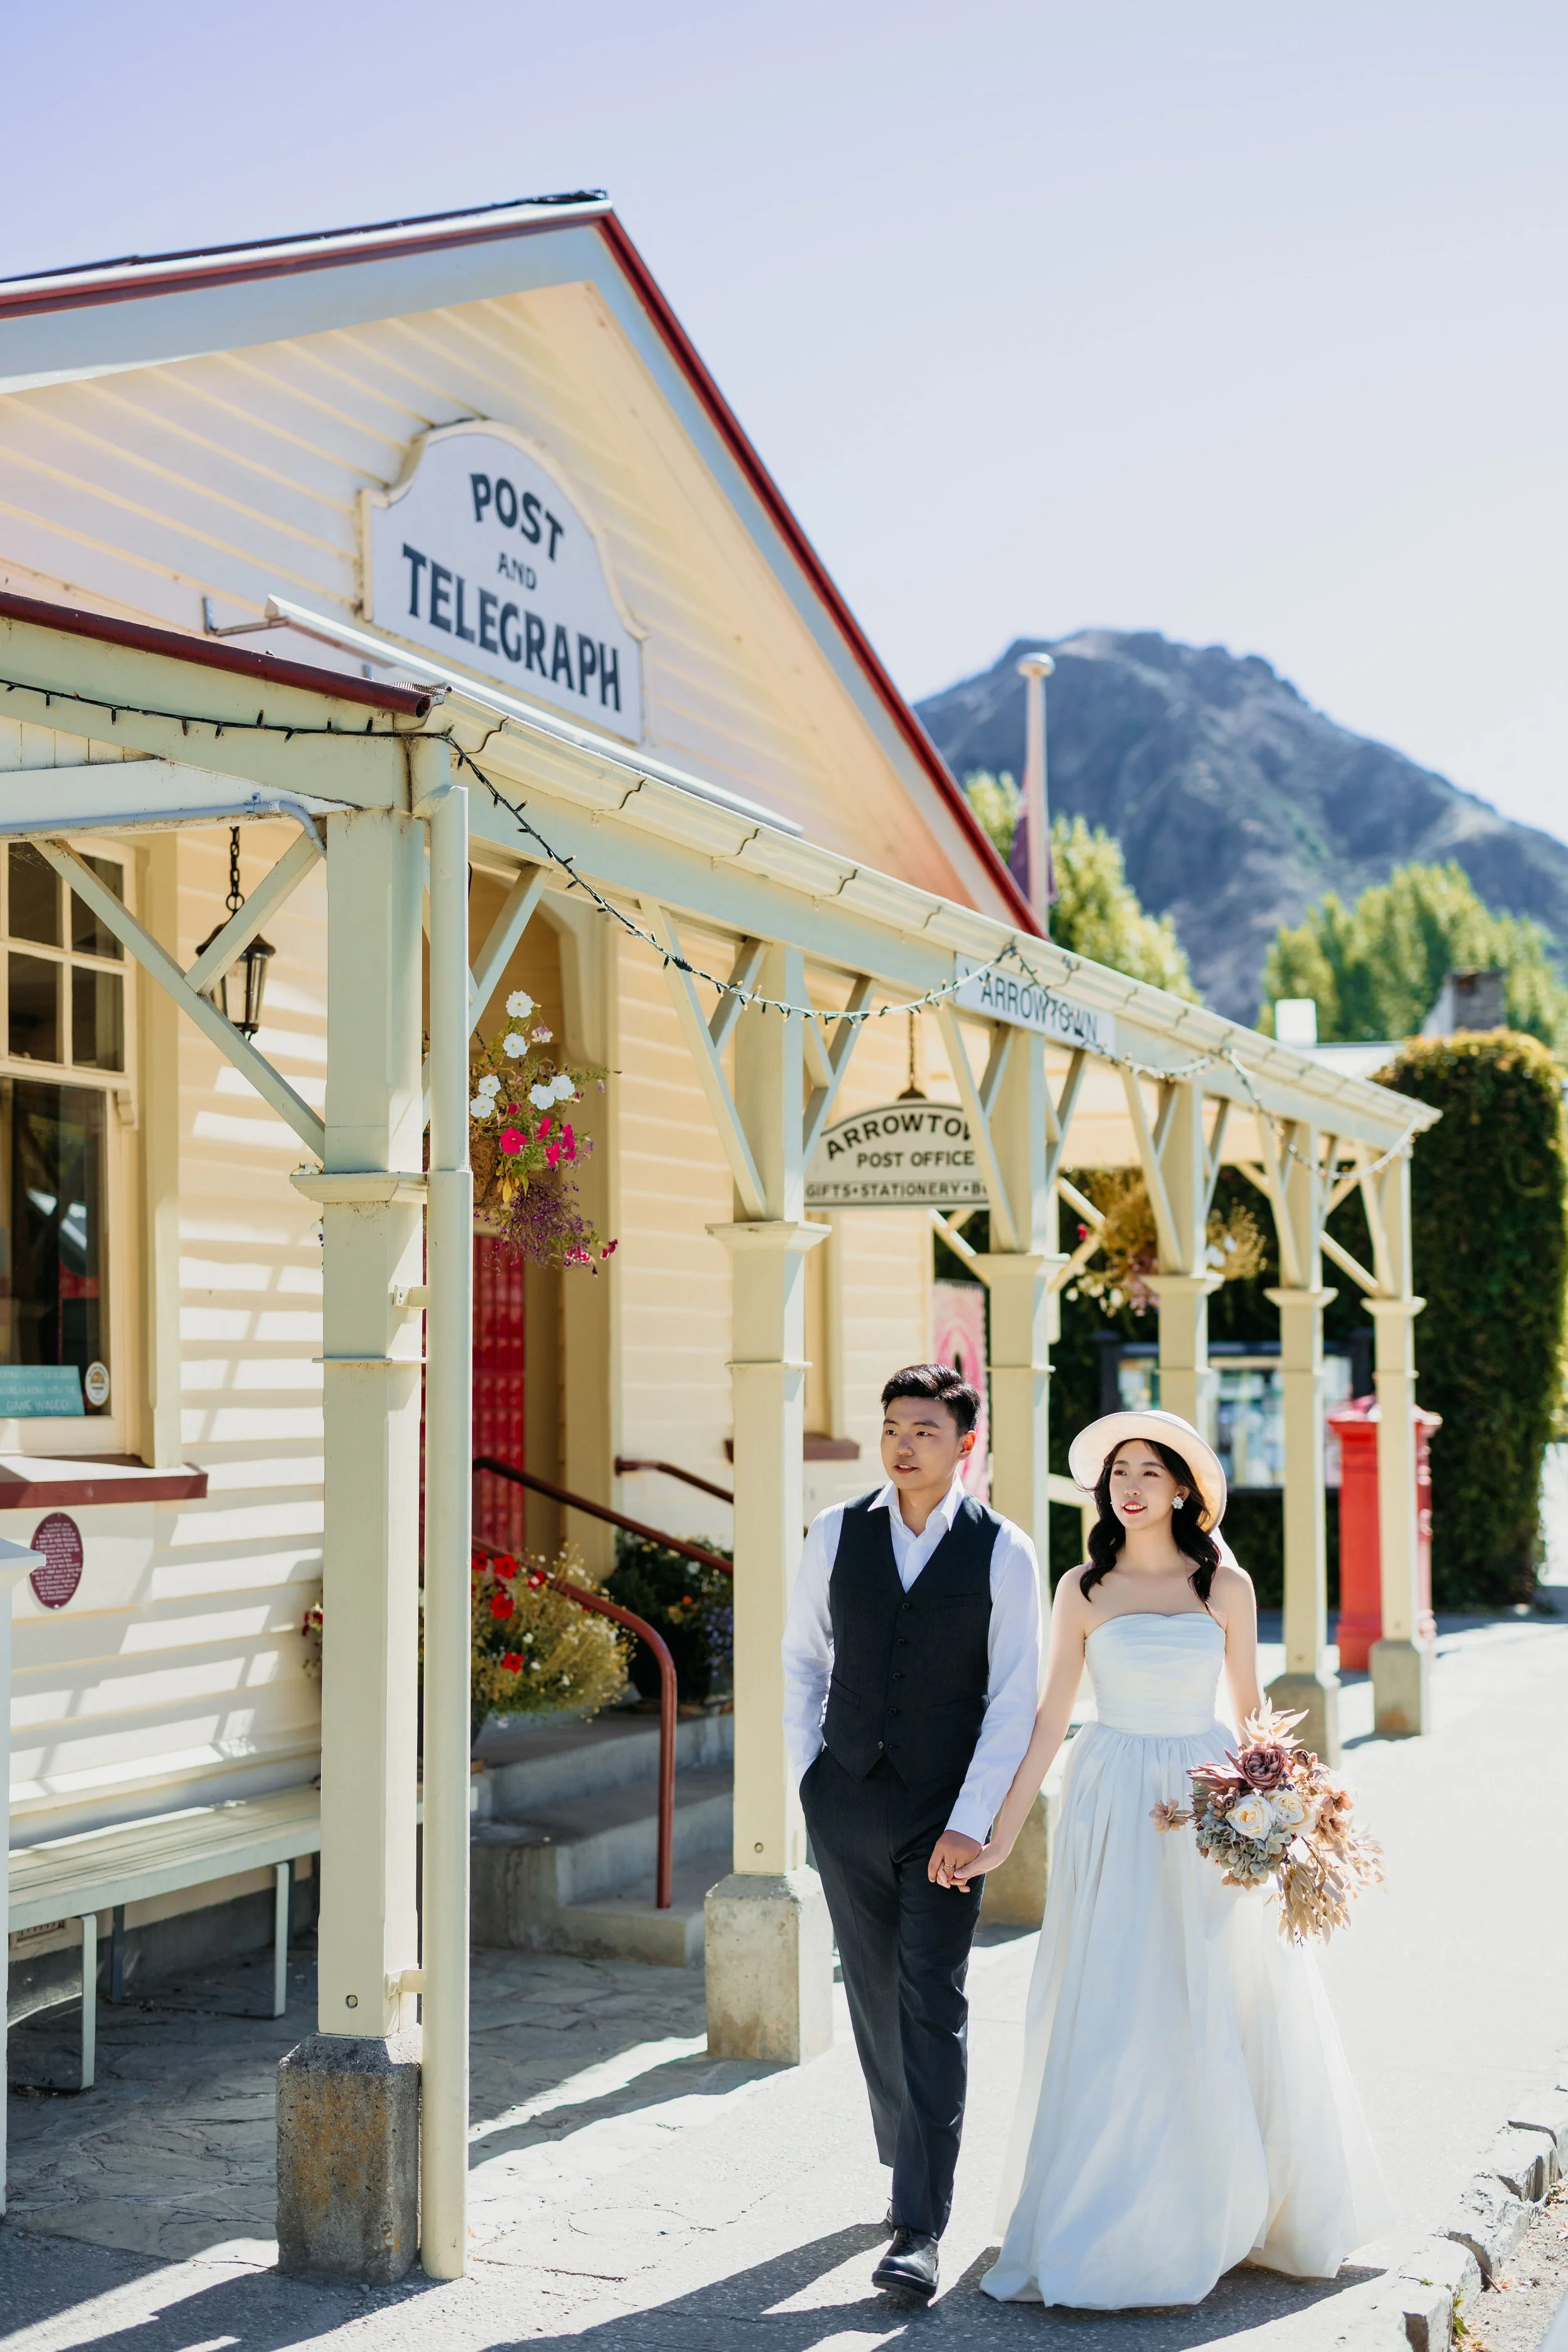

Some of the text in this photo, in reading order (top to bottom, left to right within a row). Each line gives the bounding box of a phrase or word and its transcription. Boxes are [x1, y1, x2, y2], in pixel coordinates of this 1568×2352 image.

[469, 473, 564, 563] POST
[497, 552, 537, 591] AND
[402, 542, 622, 714] TELEGRAPH
[827, 1113, 970, 1160] ARROWTO
[857, 1150, 975, 1167] POST OFFICE
